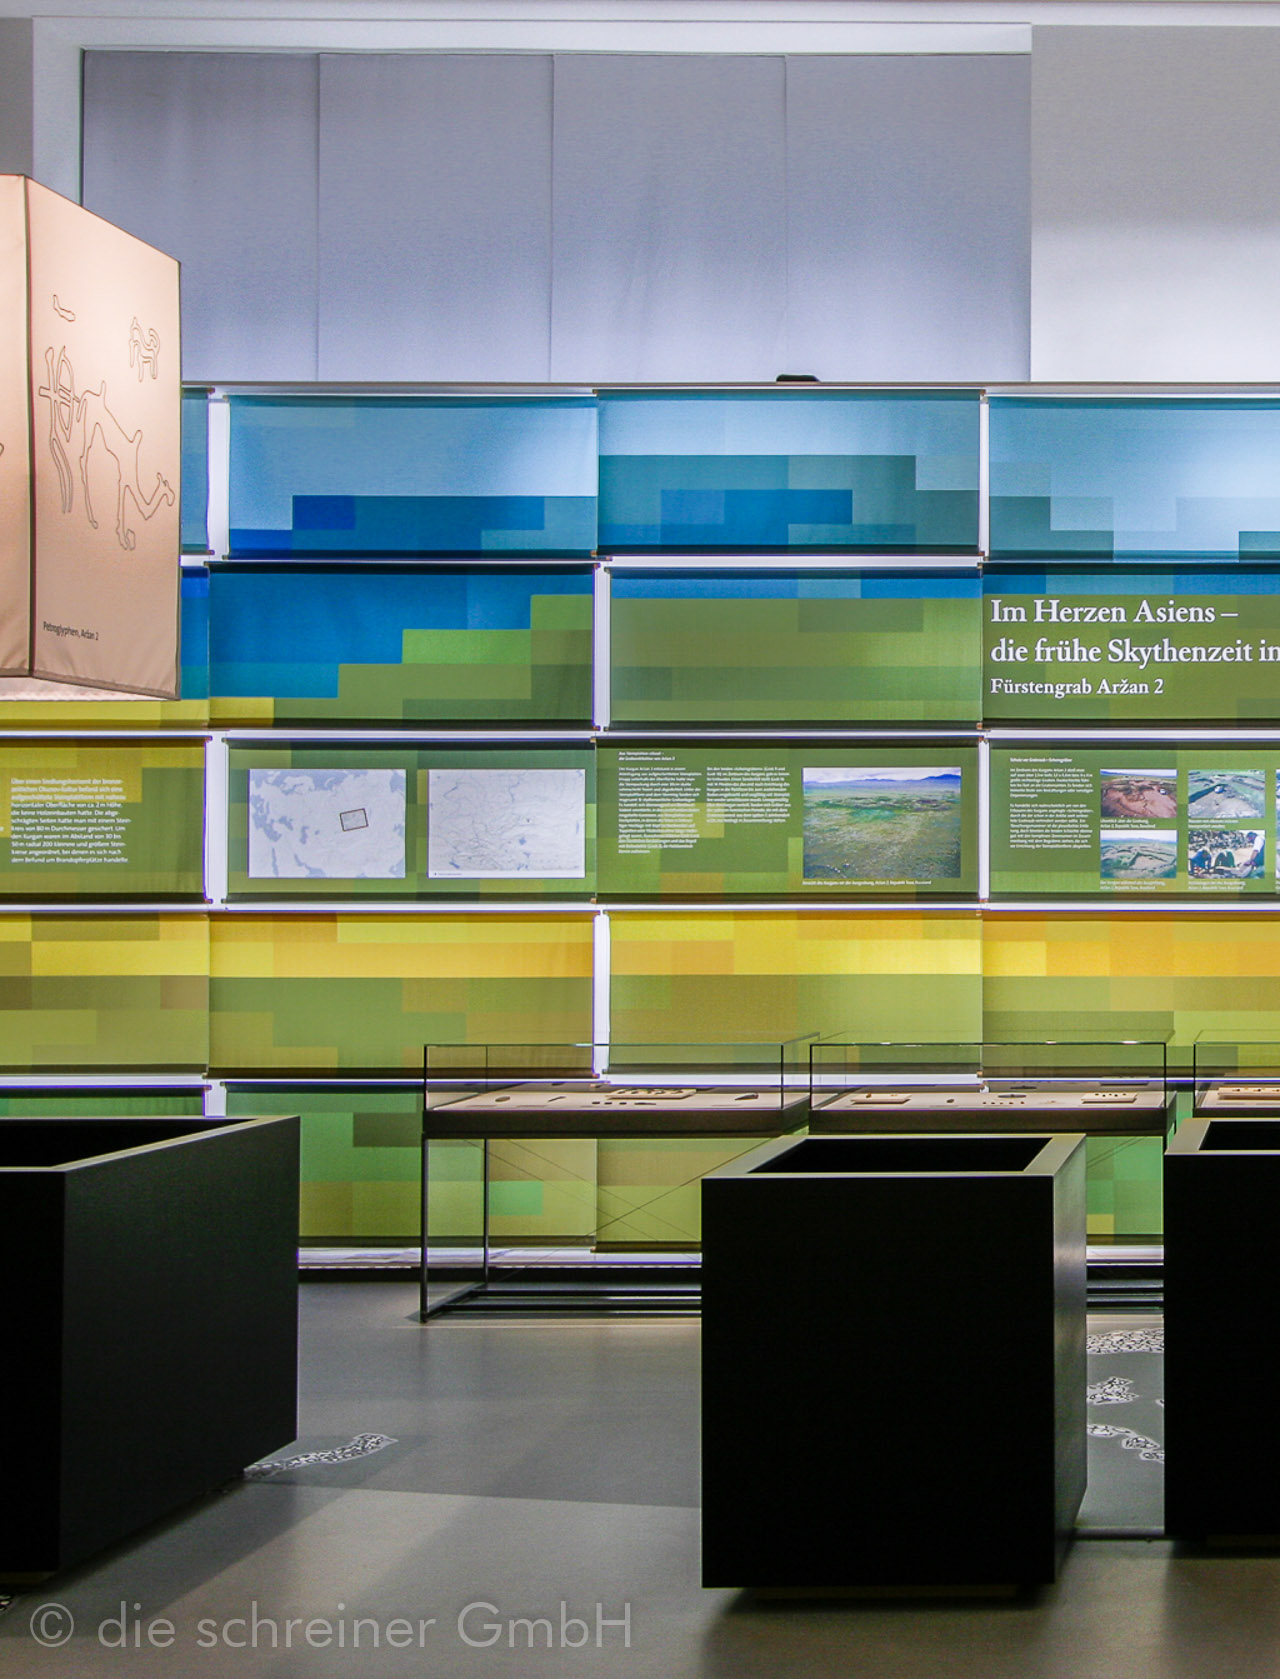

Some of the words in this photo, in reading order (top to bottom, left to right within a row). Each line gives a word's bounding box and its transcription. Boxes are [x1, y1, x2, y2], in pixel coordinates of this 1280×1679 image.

[990, 599, 1028, 623] Im
[1033, 599, 1127, 623] Herzen
[1132, 600, 1216, 623] Asiens
[990, 638, 1029, 663] die
[1034, 638, 1102, 663] frühe
[1107, 638, 1254, 670] Skythenzeit
[990, 677, 1092, 700] Fürstengrab
[1096, 677, 1150, 695] Aržan
[1153, 679, 1165, 695] 2
